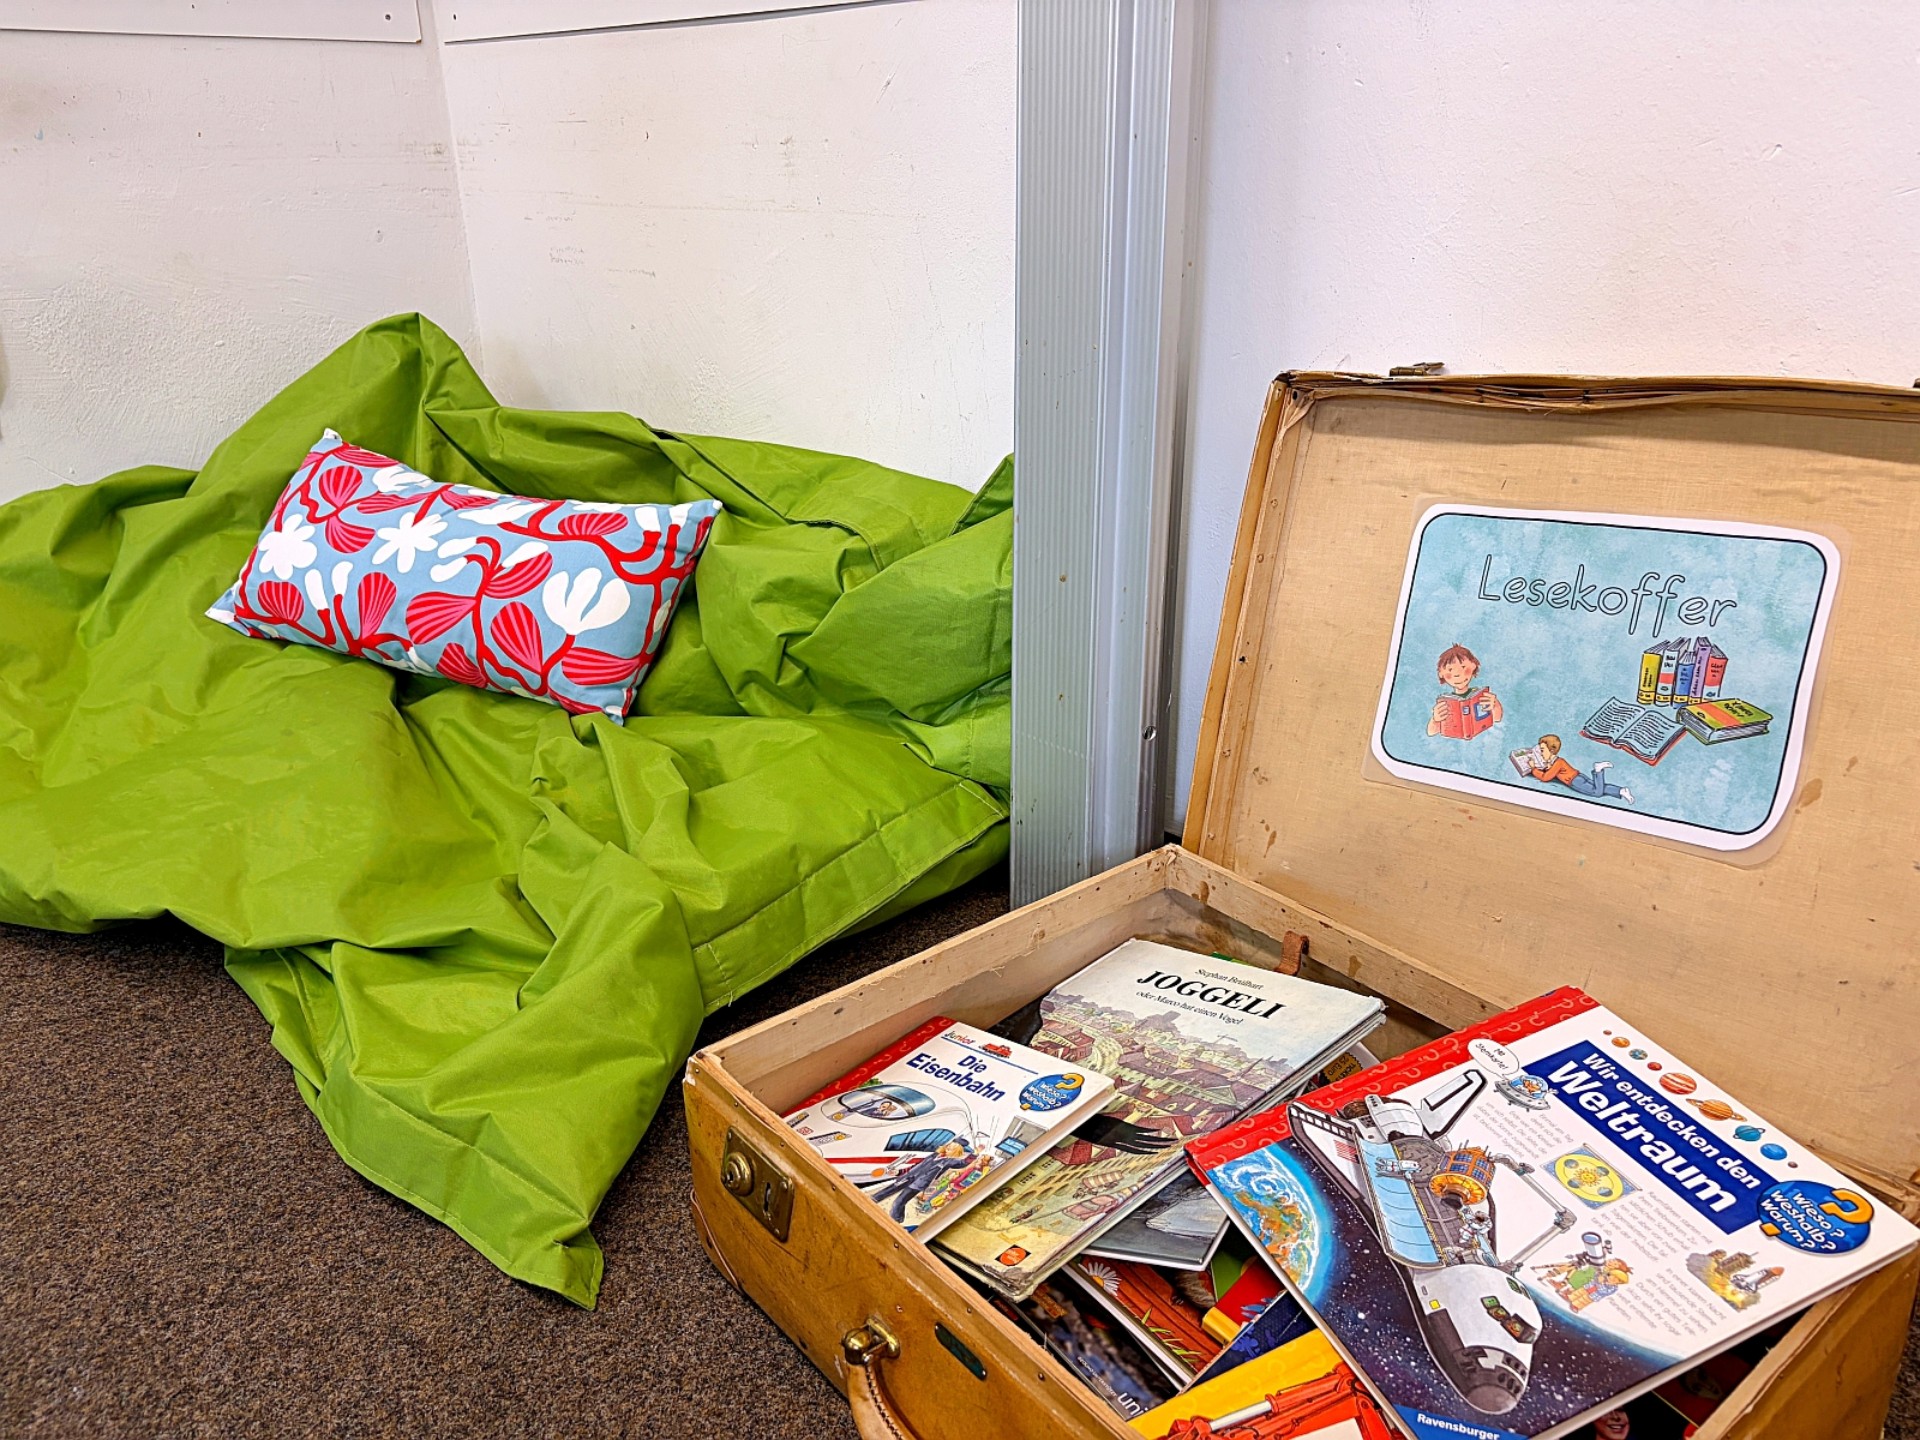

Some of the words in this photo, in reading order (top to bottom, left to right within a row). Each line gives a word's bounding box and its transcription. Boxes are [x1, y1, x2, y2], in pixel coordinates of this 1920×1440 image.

[1478, 554, 1737, 638] Lesekoffer
[1136, 970, 1287, 1019] JOGGELI
[1195, 968, 1229, 983] Stephan
[1136, 990, 1156, 1000] oder
[1154, 994, 1181, 1007] Marco
[1180, 1001, 1194, 1012] hat
[1194, 1006, 1217, 1018] einen
[1218, 1011, 1245, 1026] Vogel
[906, 1052, 1006, 1102] Eisenbahn
[957, 1055, 988, 1074] Die
[1547, 1060, 1737, 1213] Weltraum
[1582, 1052, 1620, 1081] Wir
[1616, 1081, 1720, 1158] entdecken
[1716, 1152, 1762, 1190] den
[1760, 1199, 1815, 1248] Warum?
[1770, 1190, 1837, 1250] Weshalb?
[1792, 1192, 1845, 1238] Wieso?
[1416, 1413, 1500, 1440] Ravensburger
